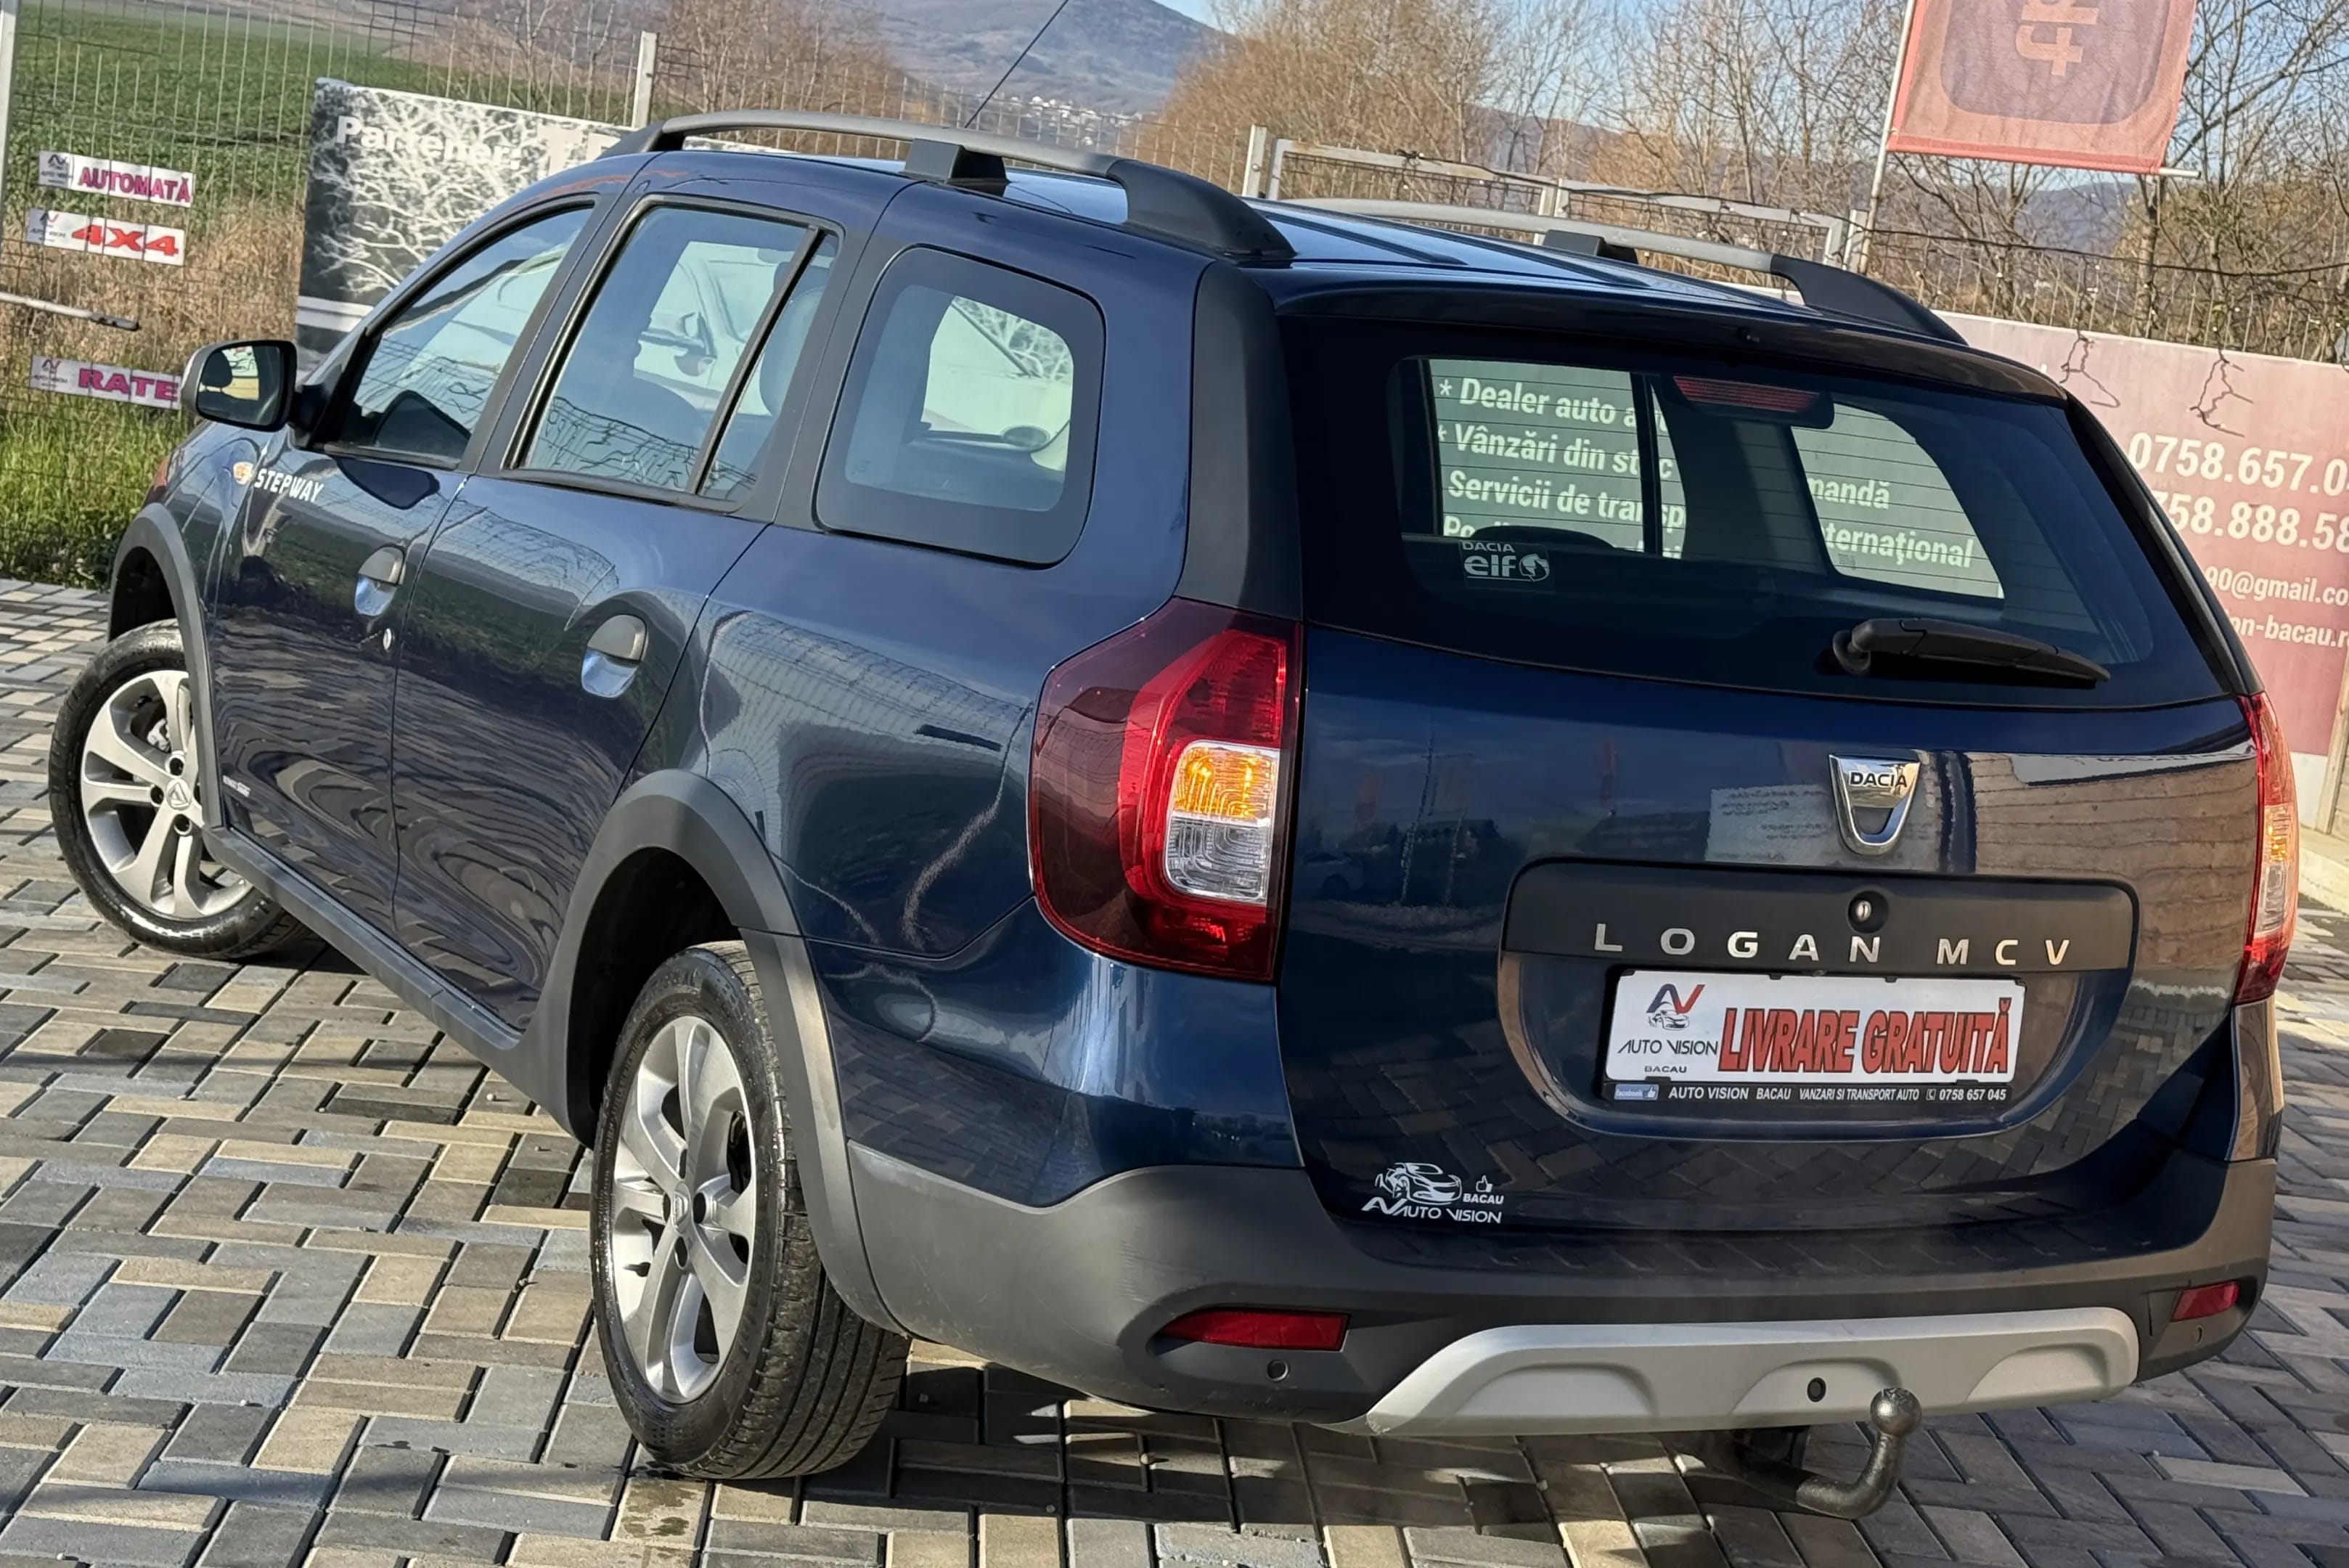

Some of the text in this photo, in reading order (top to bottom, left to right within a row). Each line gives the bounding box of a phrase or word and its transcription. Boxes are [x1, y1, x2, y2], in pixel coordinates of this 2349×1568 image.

[78, 167, 190, 203] AUTOMATĂ
[78, 368, 179, 402] RATE
[1459, 377, 1551, 416] Dealer
[1555, 396, 1617, 425] auto
[1455, 423, 1672, 479] Vânzări din stc
[2127, 432, 2349, 497] 0758.657.0
[254, 467, 324, 502] STEPWAY
[1448, 470, 1552, 510] Servicii
[1557, 483, 1590, 515] de
[1461, 539, 1516, 552] DACIA
[1464, 555, 1516, 577] elf
[2204, 565, 2349, 607] 90@gmail.co
[1849, 772, 1908, 788] DACIA
[1594, 923, 2070, 965] LOGAN MCV
[1617, 1040, 1719, 1055] AUTO VISION
[1717, 997, 2012, 1074] LIVRARE GRATUITĂ
[1668, 1086, 2007, 1101] AUTO VISION BACAU VANZARI SI TRANSPORT AUTO 0758 657 045
[1392, 1205, 1442, 1220] AUTO
[1446, 1208, 1503, 1224] VISION
[1463, 1193, 1504, 1205] BACAU
